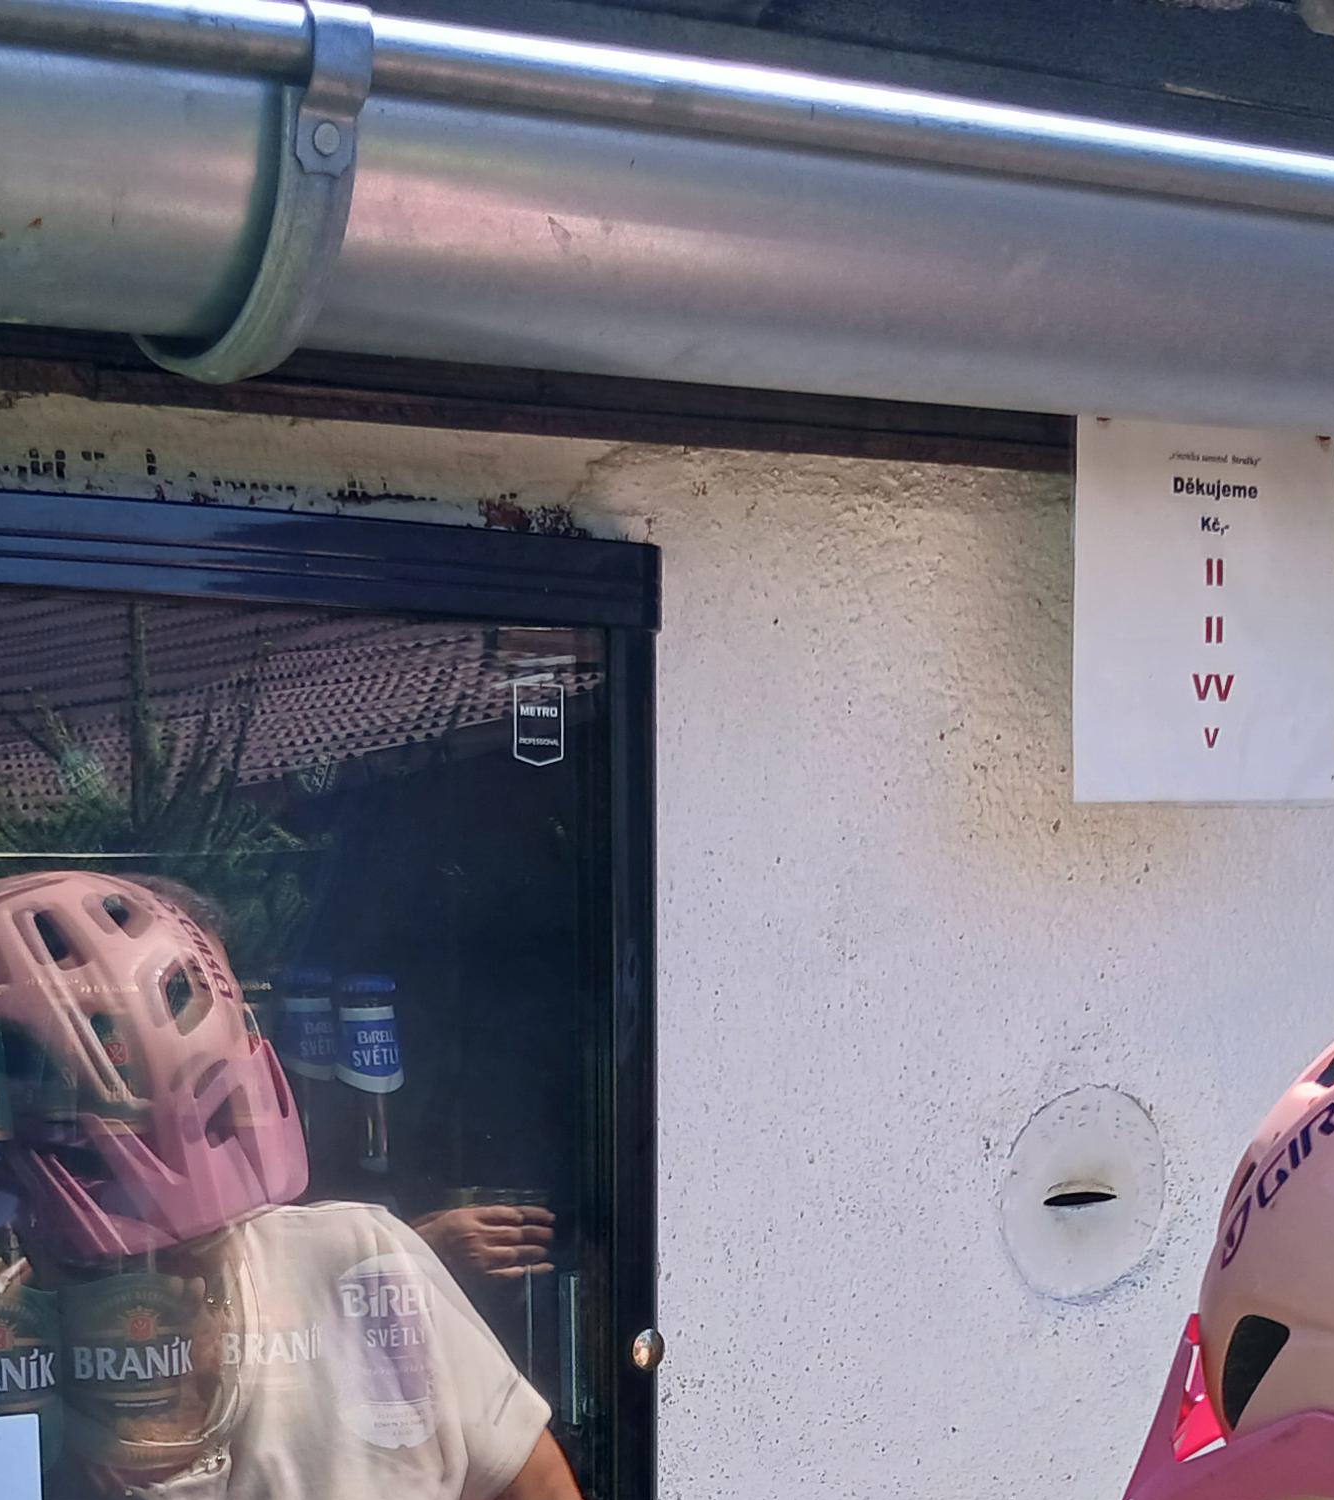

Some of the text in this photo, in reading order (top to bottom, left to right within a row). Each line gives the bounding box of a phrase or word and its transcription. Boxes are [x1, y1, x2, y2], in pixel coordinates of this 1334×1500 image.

[1172, 476, 1259, 501] Děkujeme
[520, 704, 559, 718] METRO
[73, 1335, 194, 1382] BRANÍK
